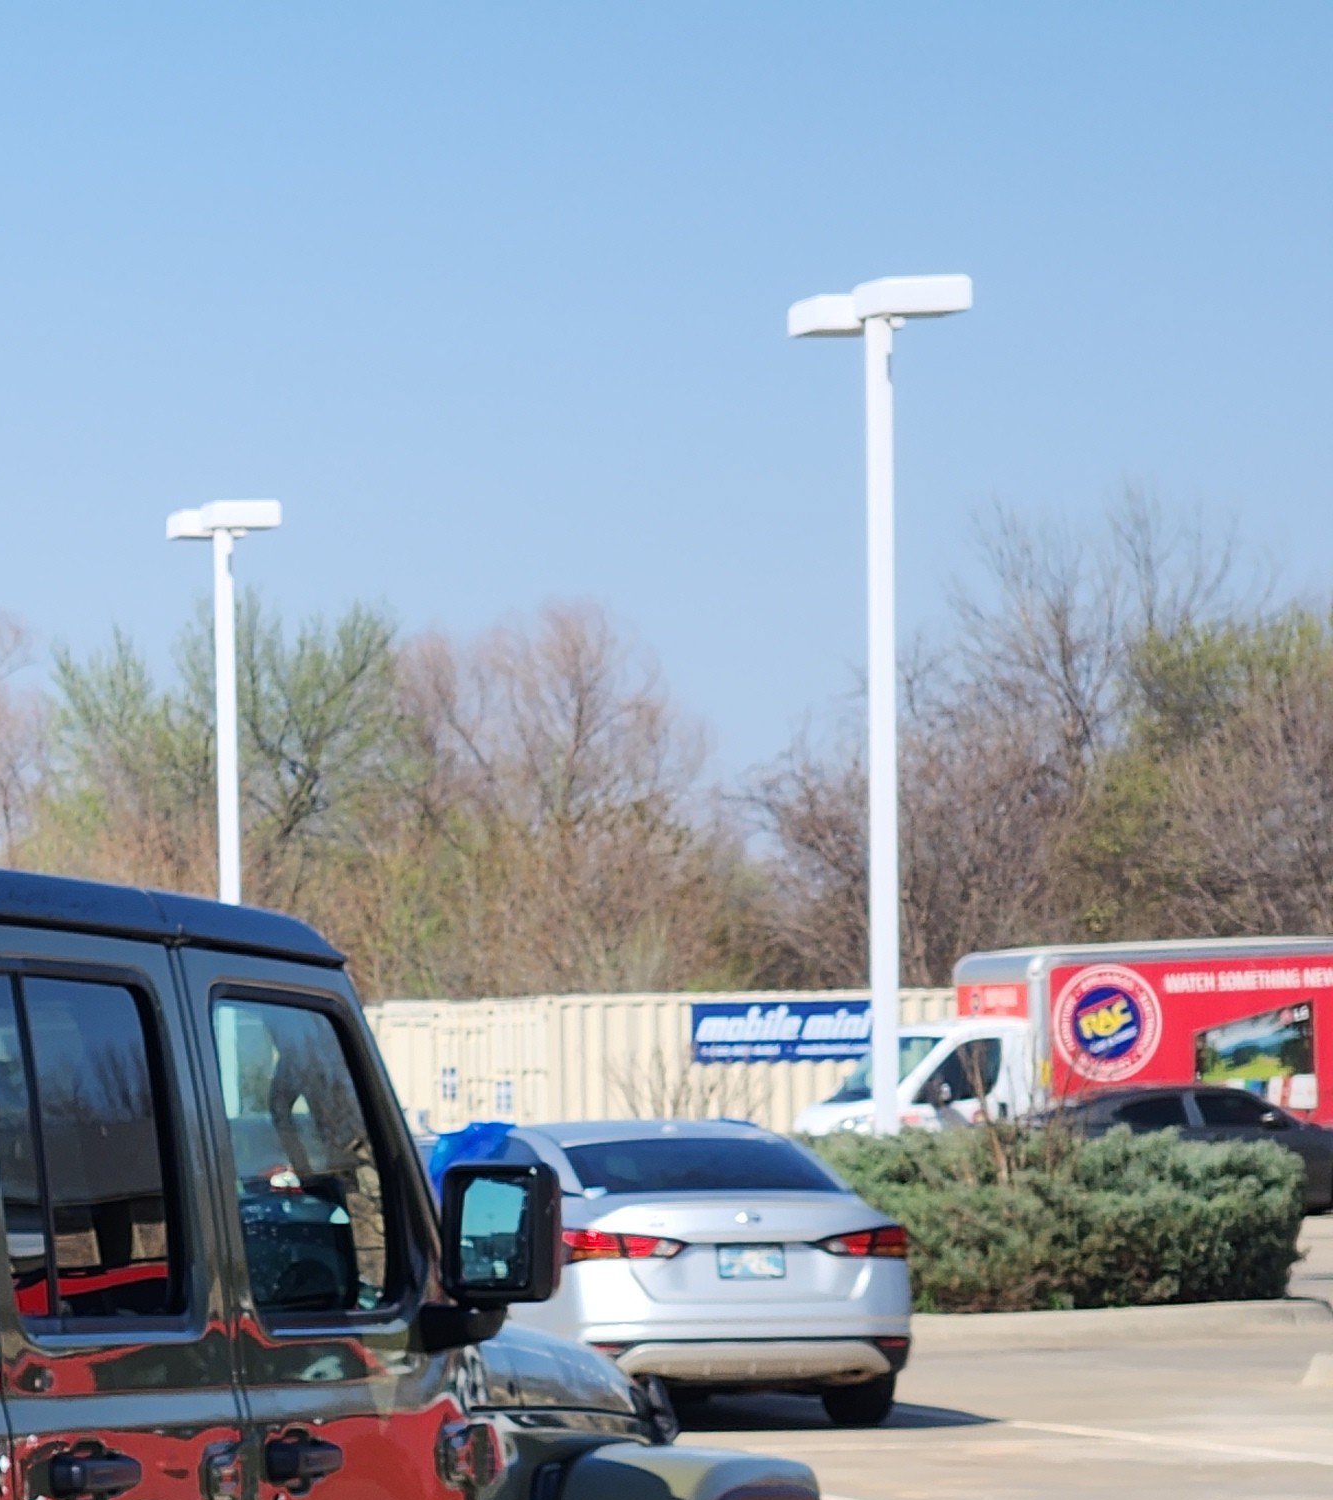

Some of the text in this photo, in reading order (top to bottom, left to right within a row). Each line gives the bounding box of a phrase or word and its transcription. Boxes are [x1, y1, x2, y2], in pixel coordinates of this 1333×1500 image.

[1164, 972, 1216, 993] WATCH
[1217, 968, 1301, 991] SOMETHING
[695, 1005, 802, 1042] mobile
[1293, 1005, 1310, 1022] LG
